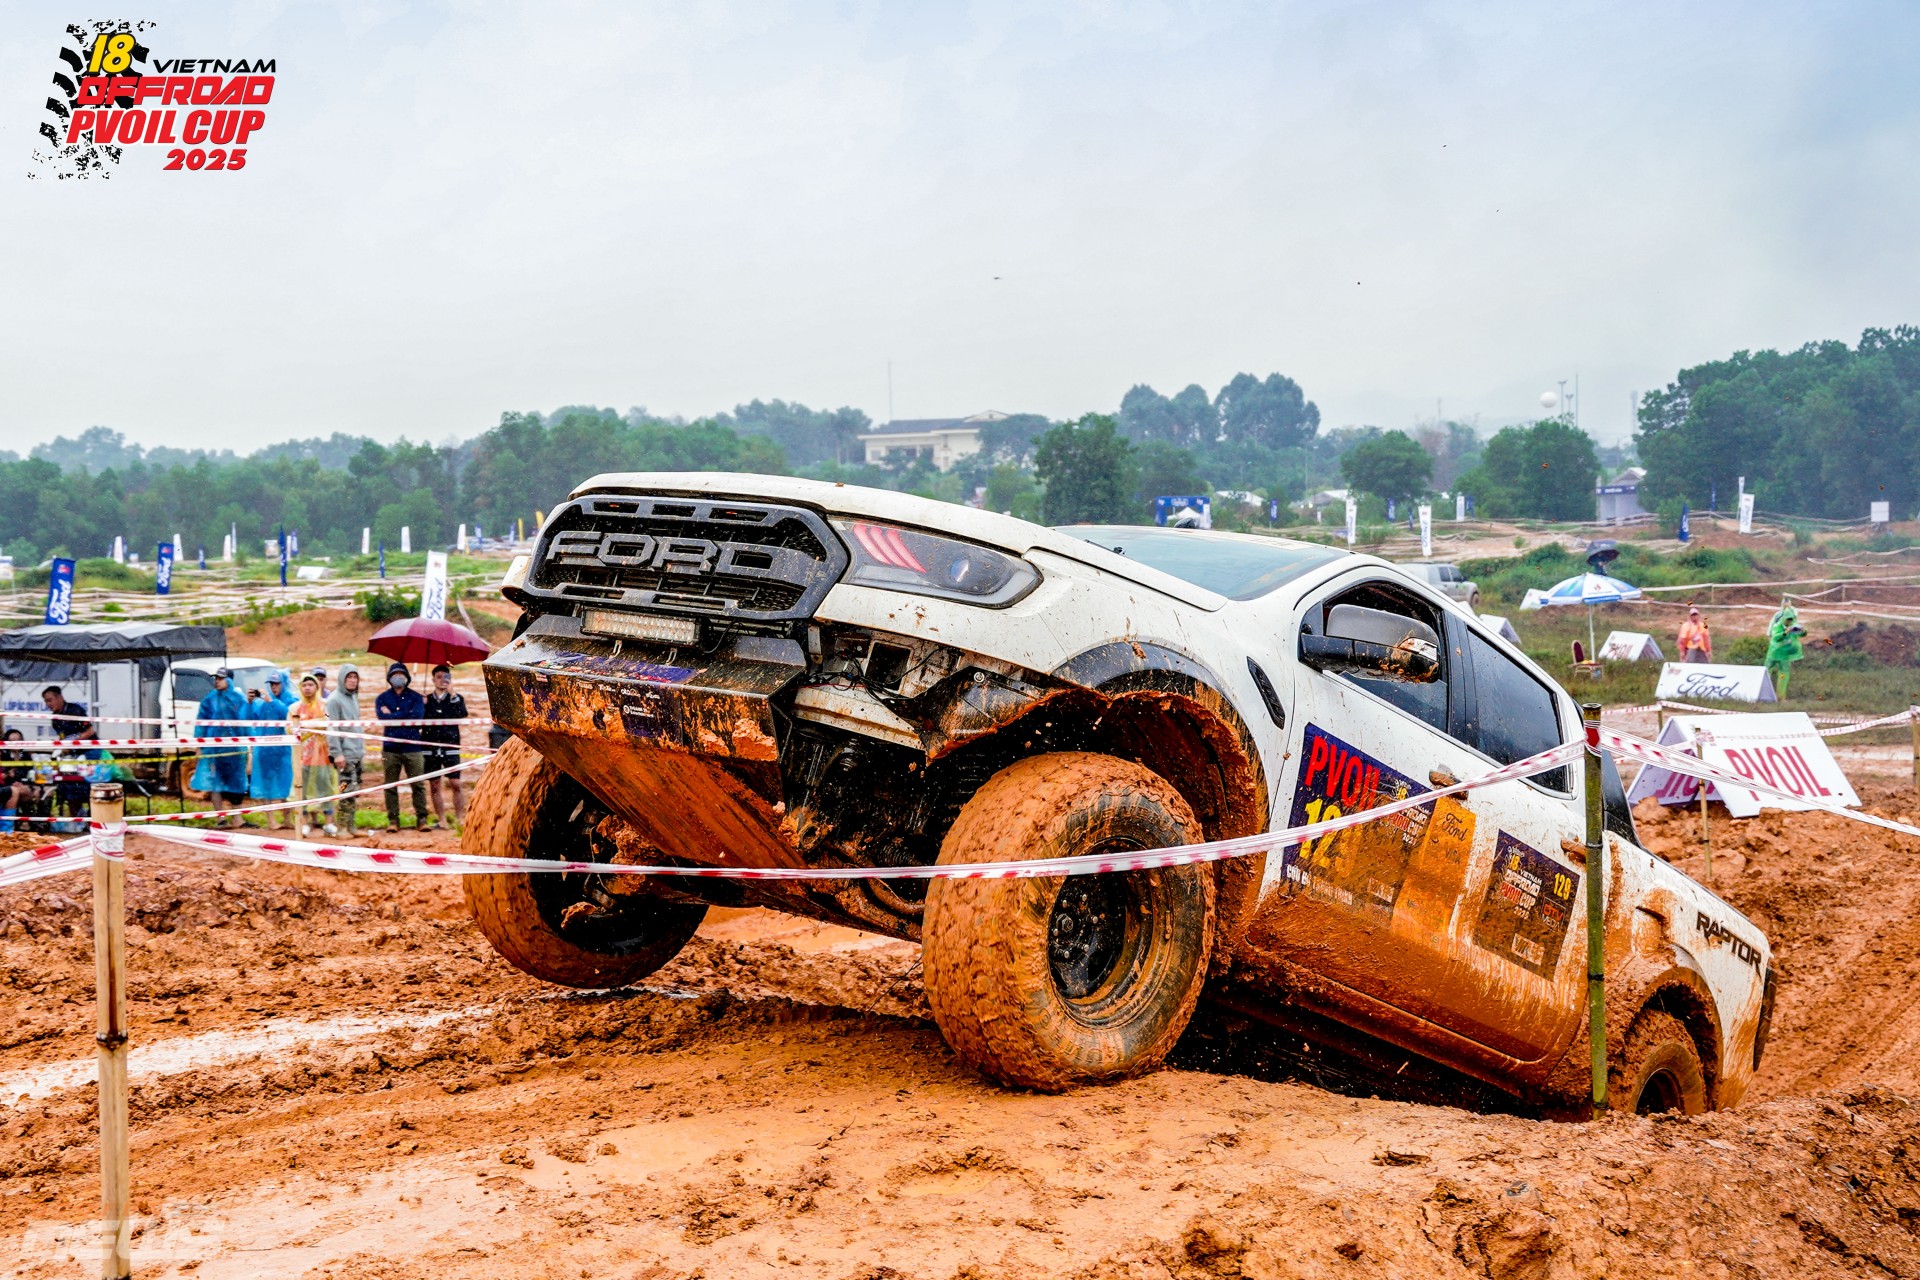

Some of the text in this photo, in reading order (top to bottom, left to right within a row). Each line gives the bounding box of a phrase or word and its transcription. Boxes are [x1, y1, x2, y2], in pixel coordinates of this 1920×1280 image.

[546, 530, 800, 584] FORD
[157, 557, 171, 588] Ford
[50, 579, 71, 624] Ford
[427, 577, 443, 619] Ford
[1677, 673, 1740, 698] Ford
[1723, 746, 1832, 801] PVOIL
[1442, 812, 1468, 842] Ford
[1509, 854, 1521, 871] 18
[1520, 868, 1542, 886] VIETNAM
[1554, 872, 1572, 901] 129
[1519, 893, 1537, 911] CUP
[1696, 911, 1763, 981] RAPTOR
